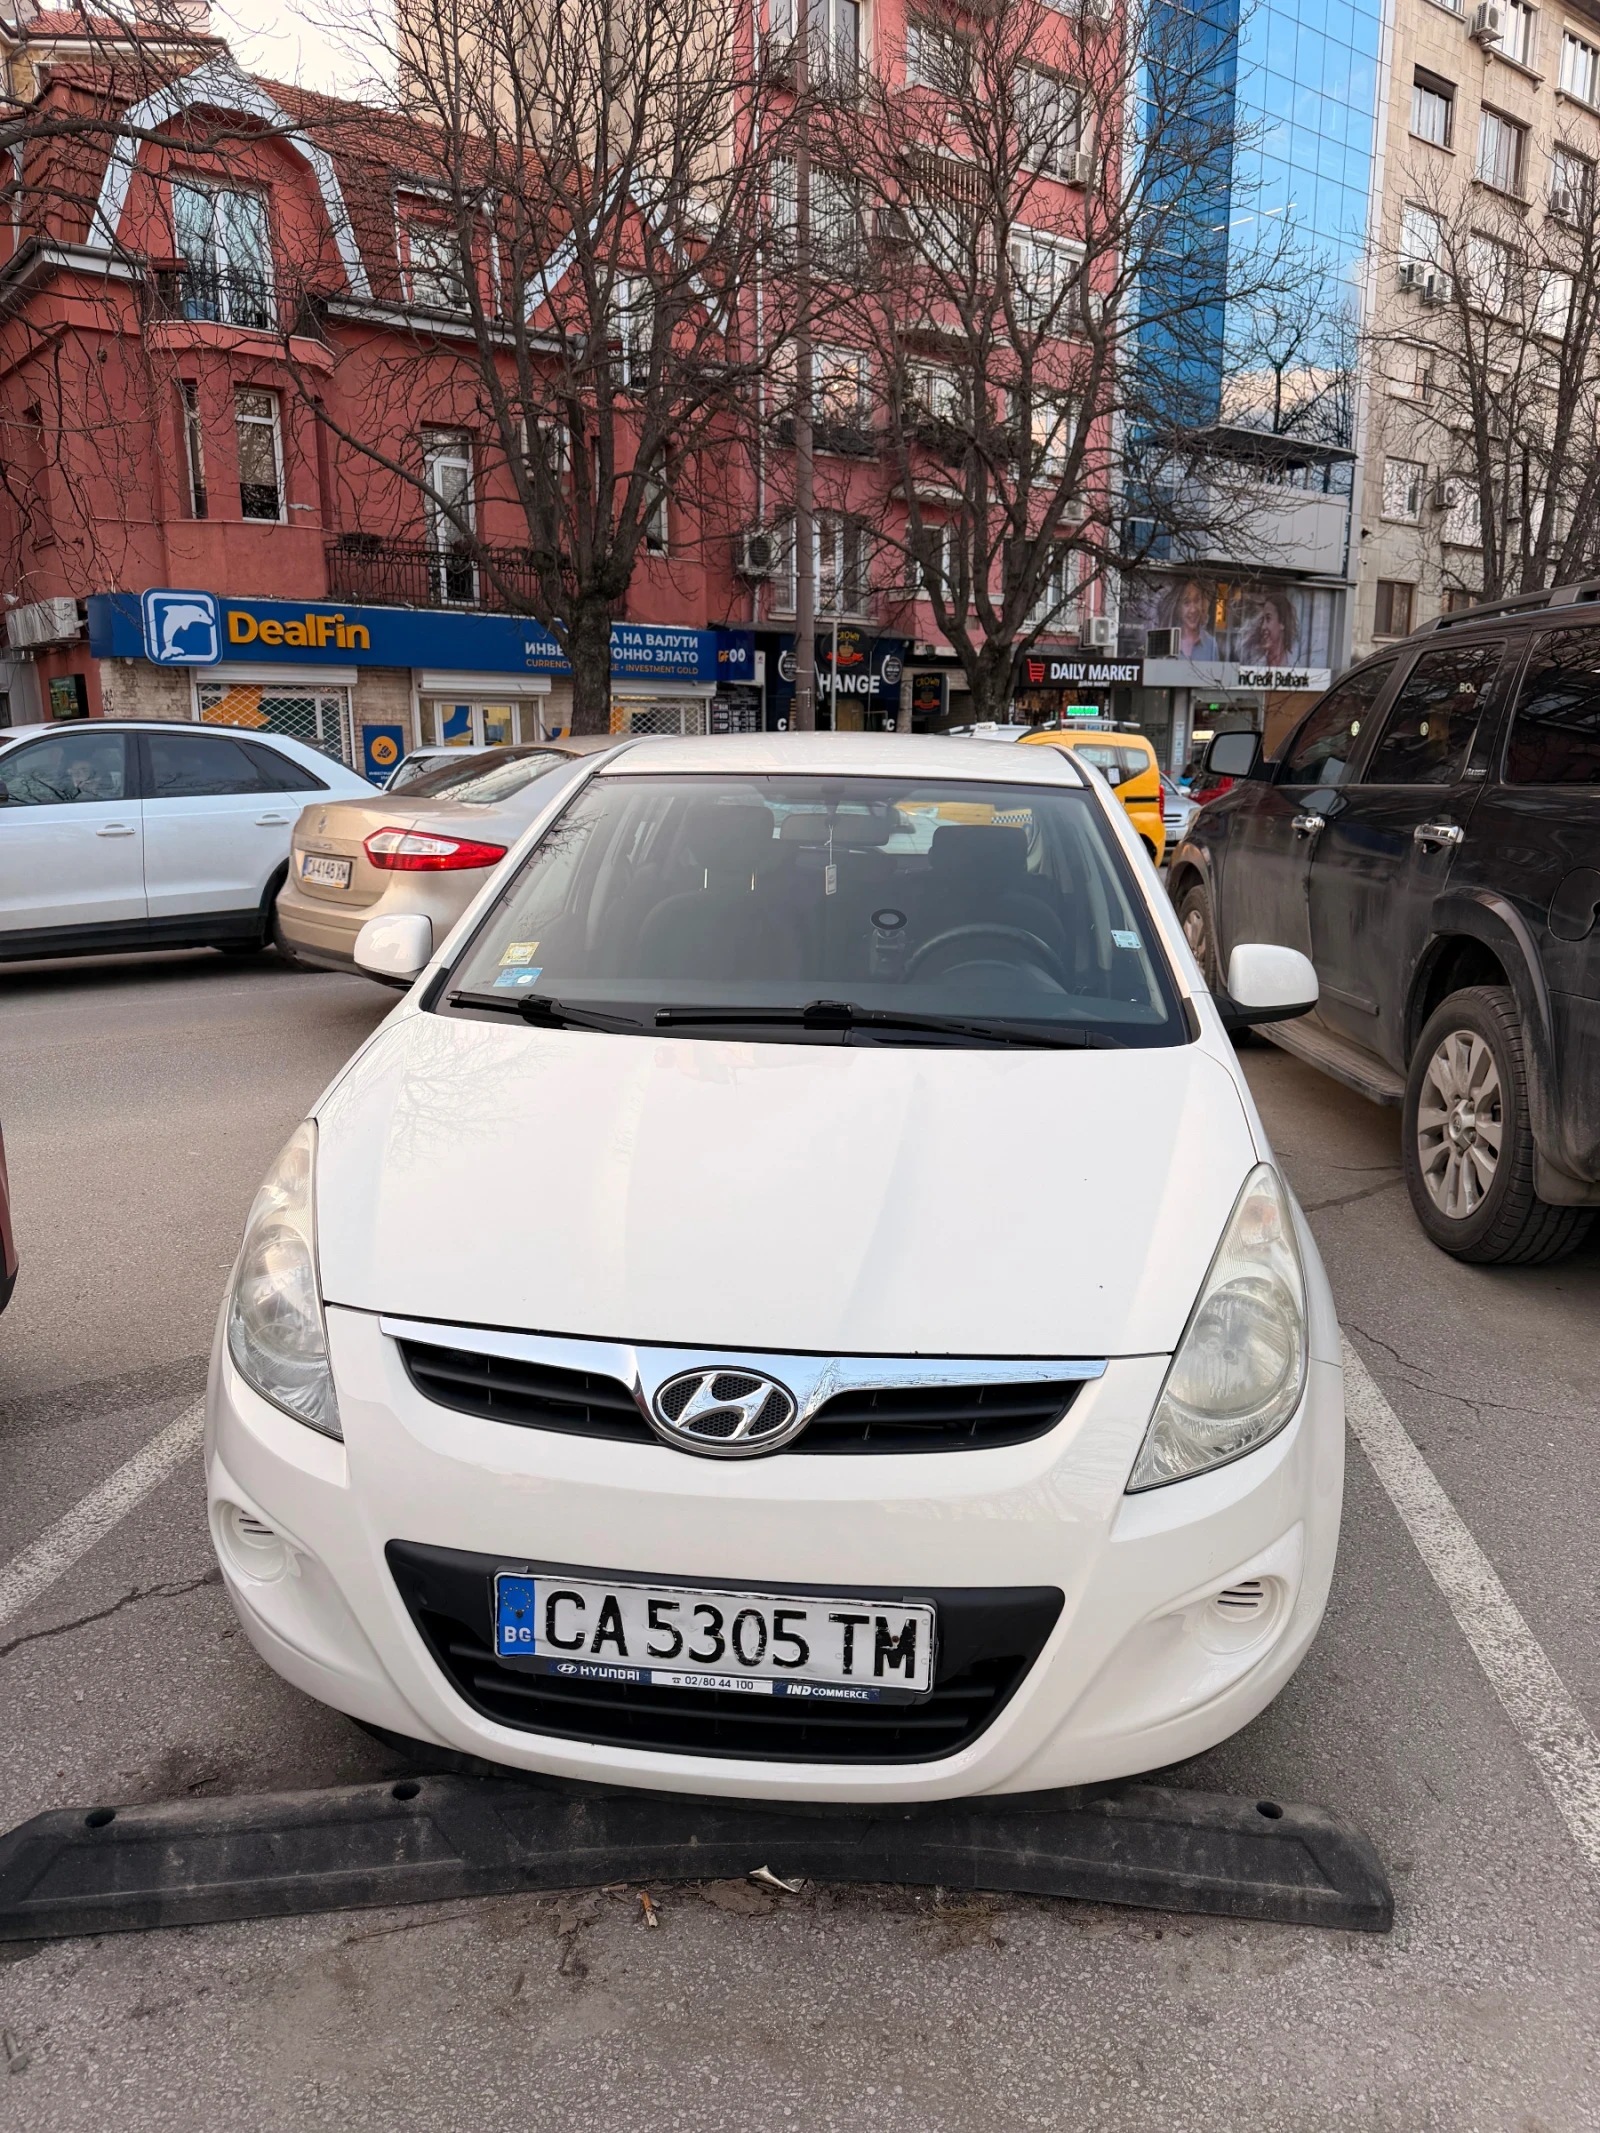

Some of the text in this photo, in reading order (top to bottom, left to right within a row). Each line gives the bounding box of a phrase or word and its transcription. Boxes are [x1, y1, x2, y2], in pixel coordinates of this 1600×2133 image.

[228, 611, 370, 649] DealFin
[623, 633, 643, 646] НА
[646, 633, 698, 648] ВАЛУТИ
[656, 649, 699, 663] ЗЛАТО
[526, 659, 572, 669] CURRENCY
[626, 665, 675, 674] INVESTMENT
[677, 667, 698, 675] GOLD
[1051, 662, 1140, 681] DAILY MARKET
[820, 674, 880, 693] HANGE
[1238, 670, 1273, 686] niCredit
[504, 1626, 531, 1643] BG
[546, 1589, 917, 1679] CA 5305 TM
[580, 1665, 640, 1681] HYUNDAI
[685, 1675, 716, 1687] 02/80
[718, 1679, 732, 1689] 44
[735, 1680, 754, 1691] 100
